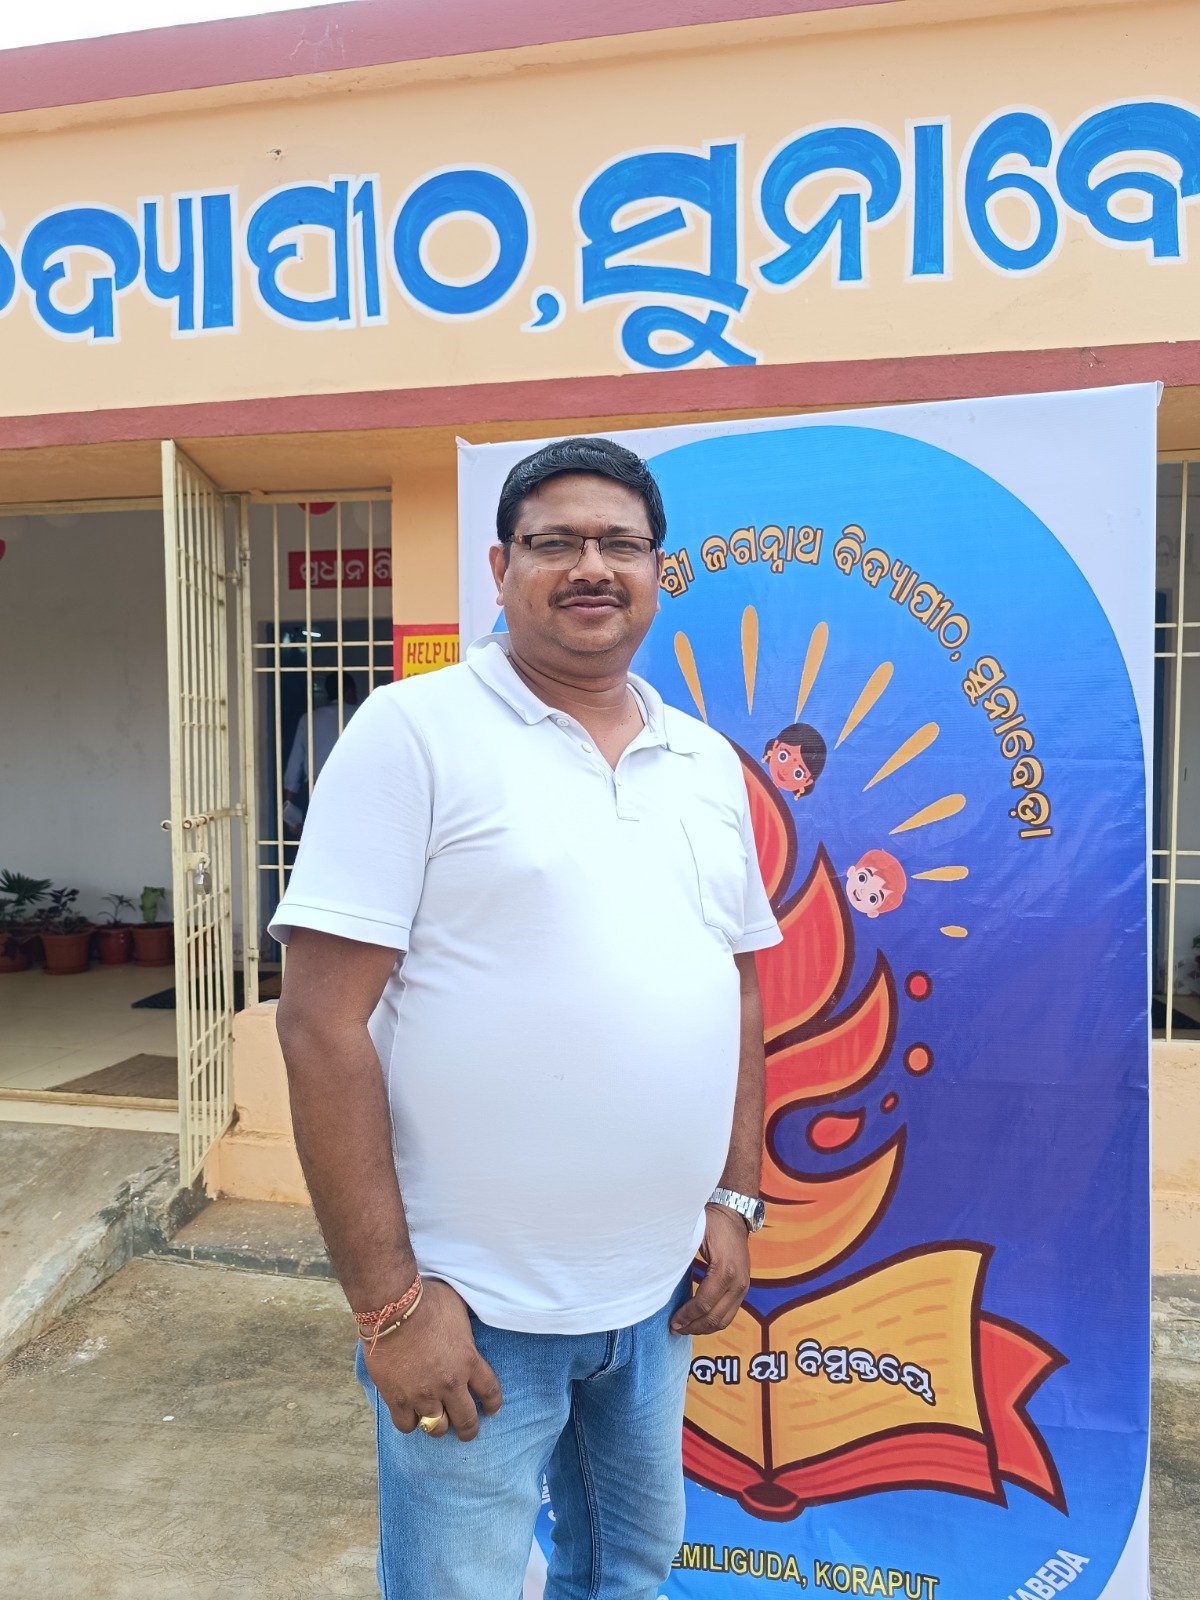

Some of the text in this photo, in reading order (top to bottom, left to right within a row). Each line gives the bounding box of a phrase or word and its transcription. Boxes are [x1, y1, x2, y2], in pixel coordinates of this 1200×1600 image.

[0, 164, 563, 342] ଦ୍ୟାପୀଠ,
[407, 642, 459, 664] HELPLI
[701, 525, 823, 573] ଜଗନ୍ନାଥ
[833, 524, 970, 662] ବିଦ୍ୟାପୀଠ,
[962, 655, 1053, 839] ସୁନାବେଡ଼ା
[690, 1356, 740, 1384] ଦ୍ୟା
[813, 1558, 939, 1600] KORAPUT
[1007, 1549, 1090, 1600] ABEDA
